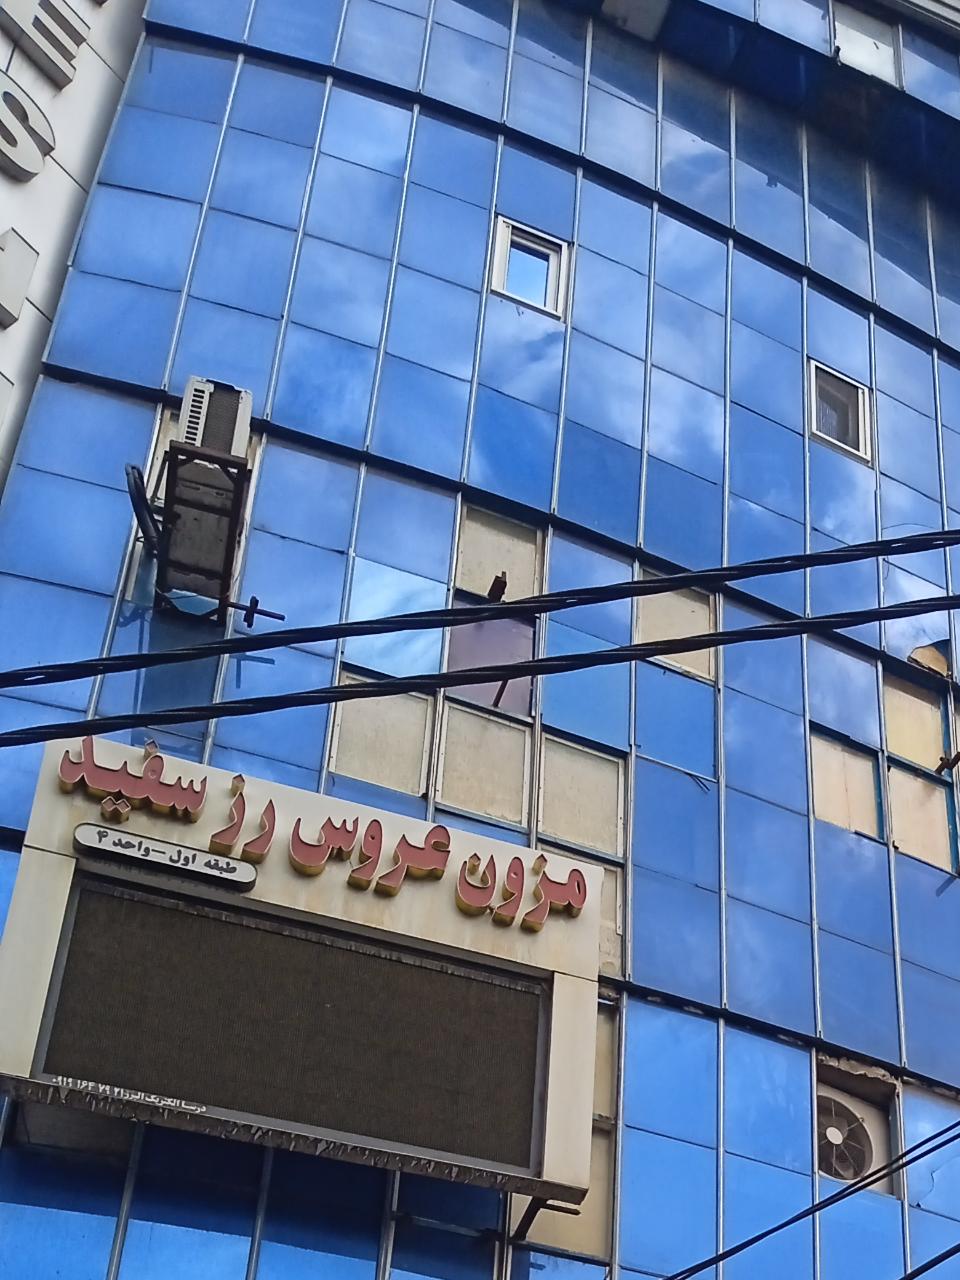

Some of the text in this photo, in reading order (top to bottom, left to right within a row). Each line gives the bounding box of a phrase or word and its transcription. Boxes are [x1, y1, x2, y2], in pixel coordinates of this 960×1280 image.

[58, 733, 587, 933] مزون عروس رز سفید
[168, 852, 197, 869] اول
[203, 858, 238, 876] طبقه
